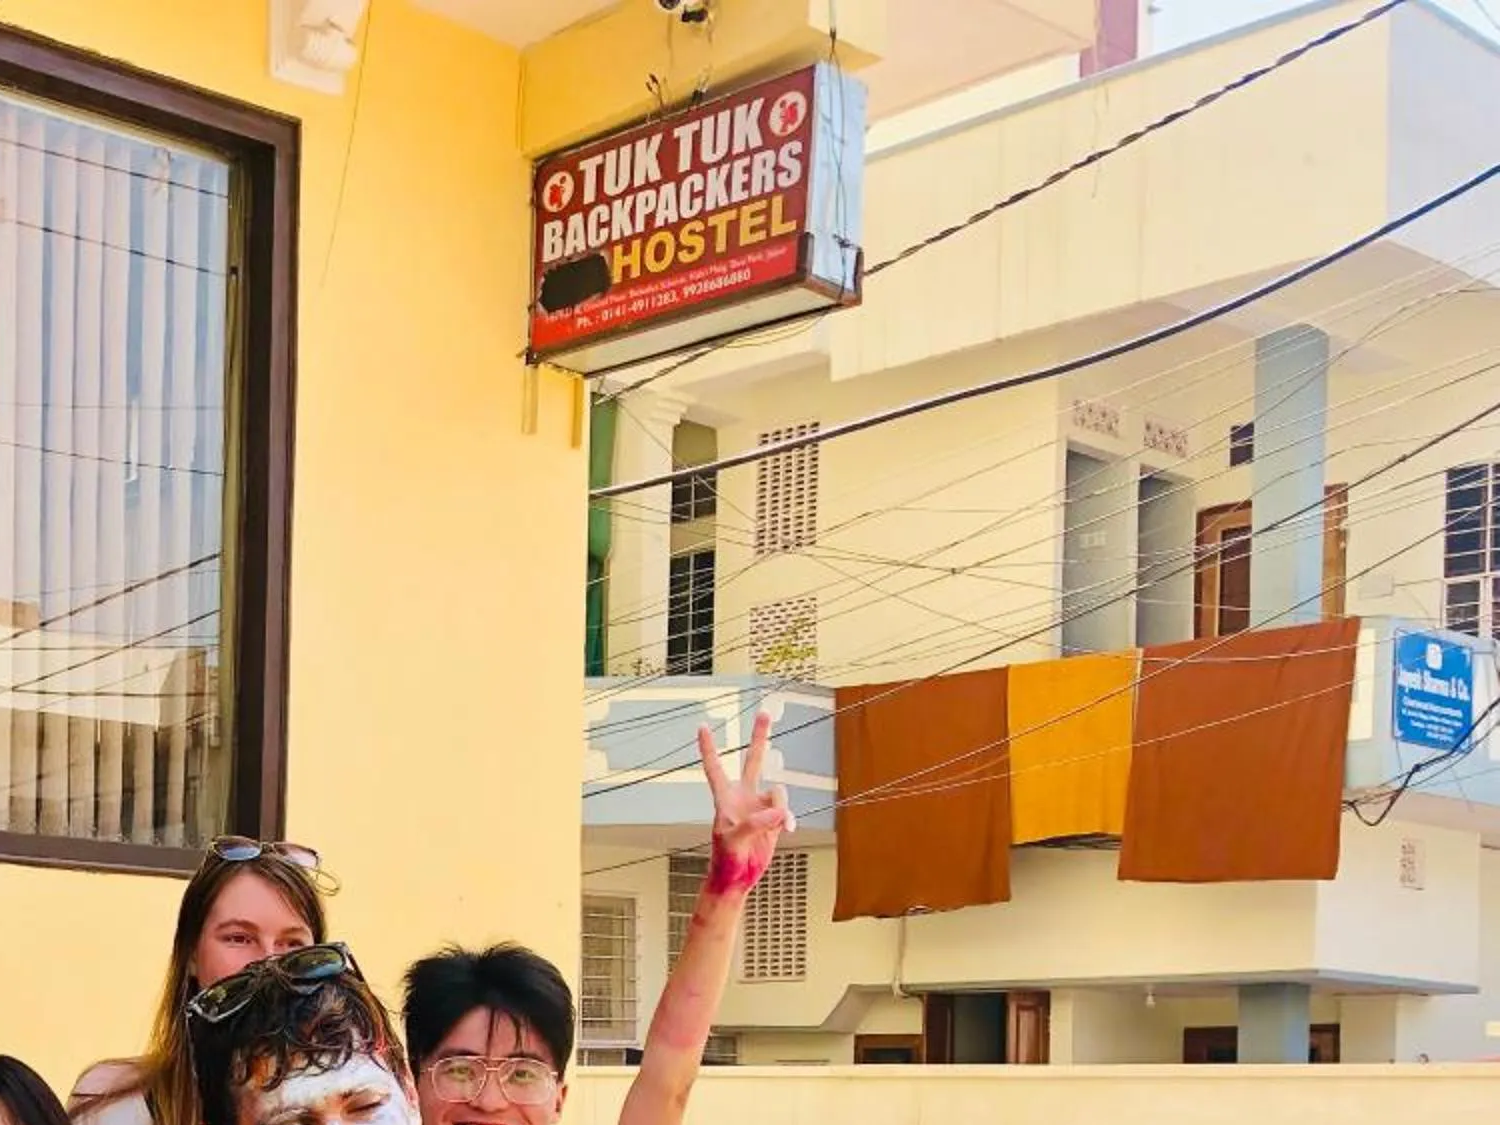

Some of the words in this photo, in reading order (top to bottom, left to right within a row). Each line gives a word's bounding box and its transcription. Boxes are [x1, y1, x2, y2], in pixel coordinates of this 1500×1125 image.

[543, 140, 803, 263] BACKPACKERS
[579, 133, 663, 205] TUK
[674, 98, 764, 173] TUK
[611, 194, 797, 285] HOSTEL
